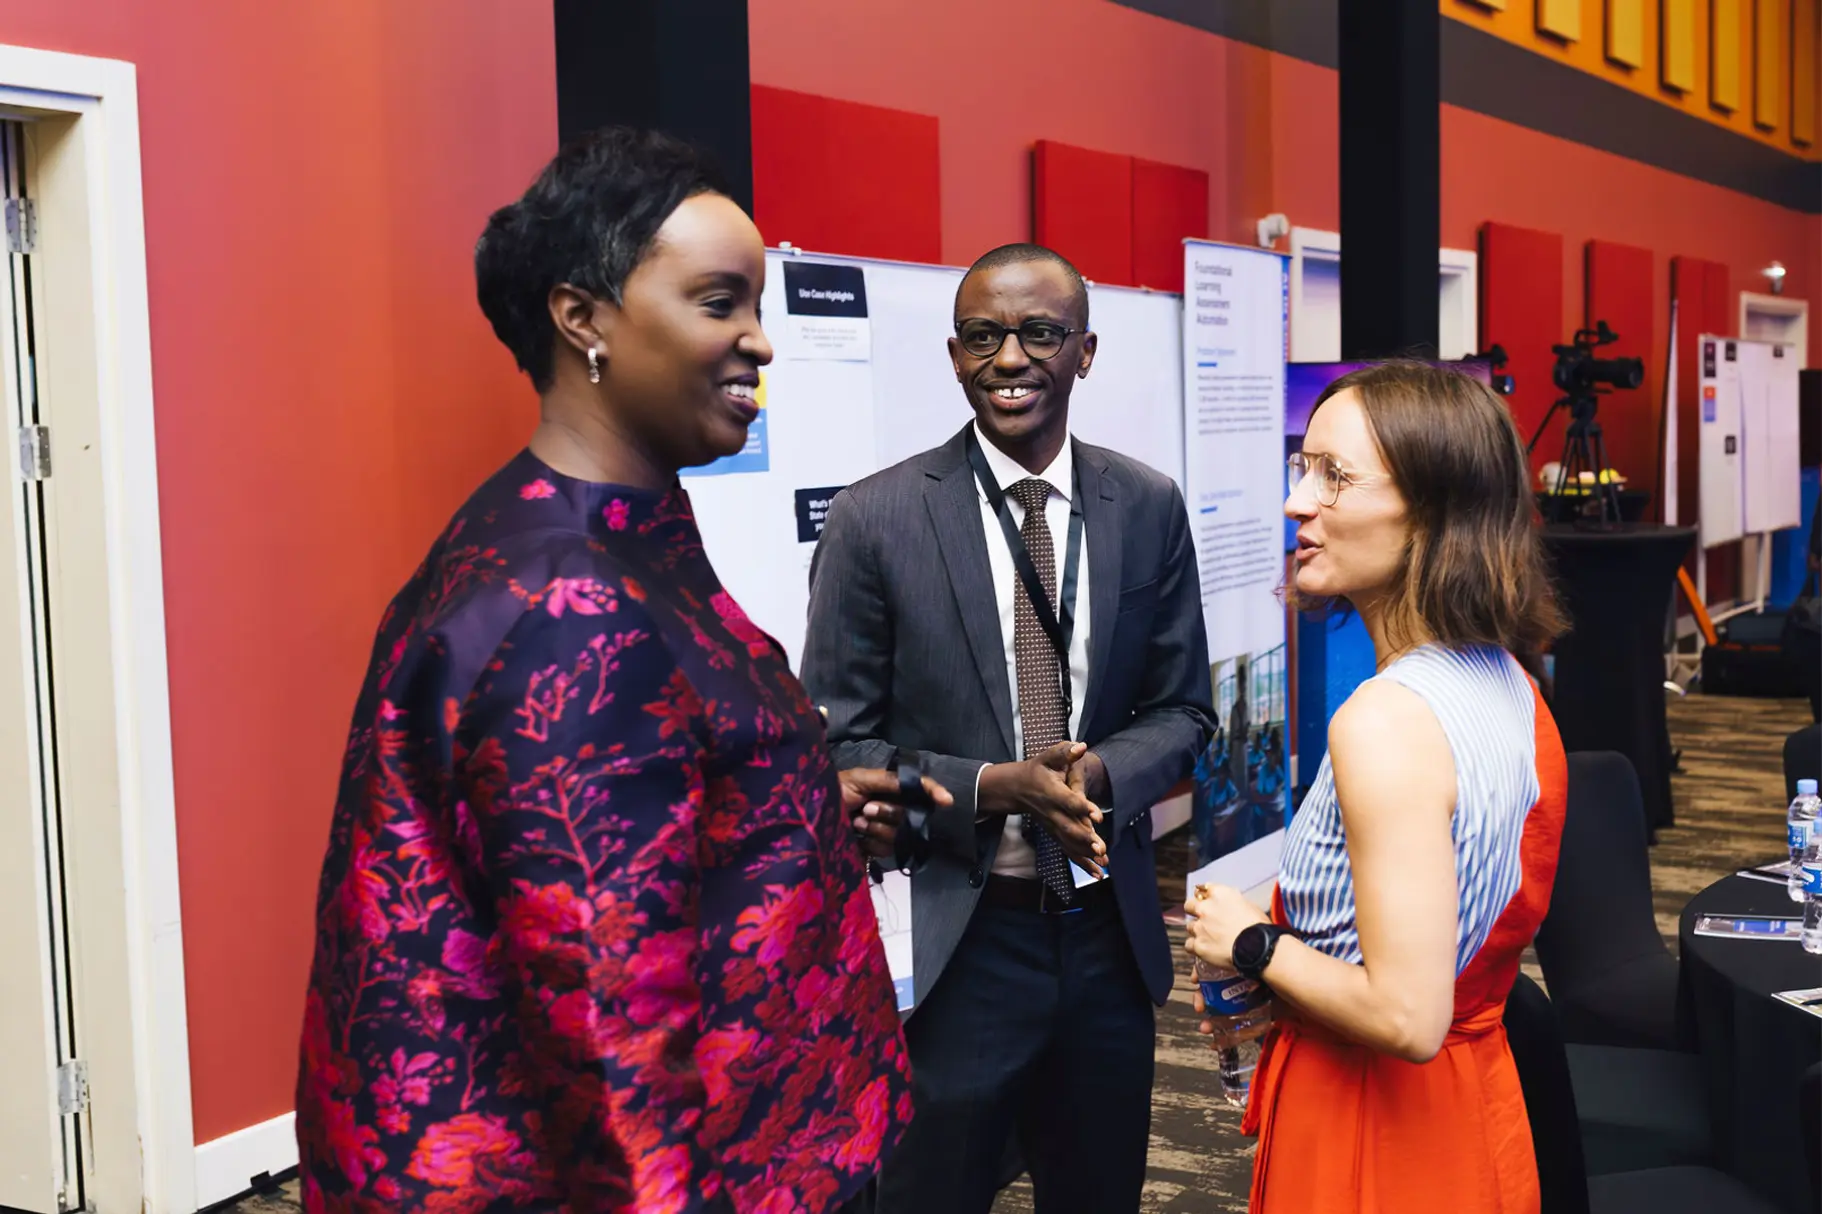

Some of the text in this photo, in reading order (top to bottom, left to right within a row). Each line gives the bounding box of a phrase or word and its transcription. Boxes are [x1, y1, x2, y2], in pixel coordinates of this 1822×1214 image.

[798, 288, 855, 302] Use Case Highlights
